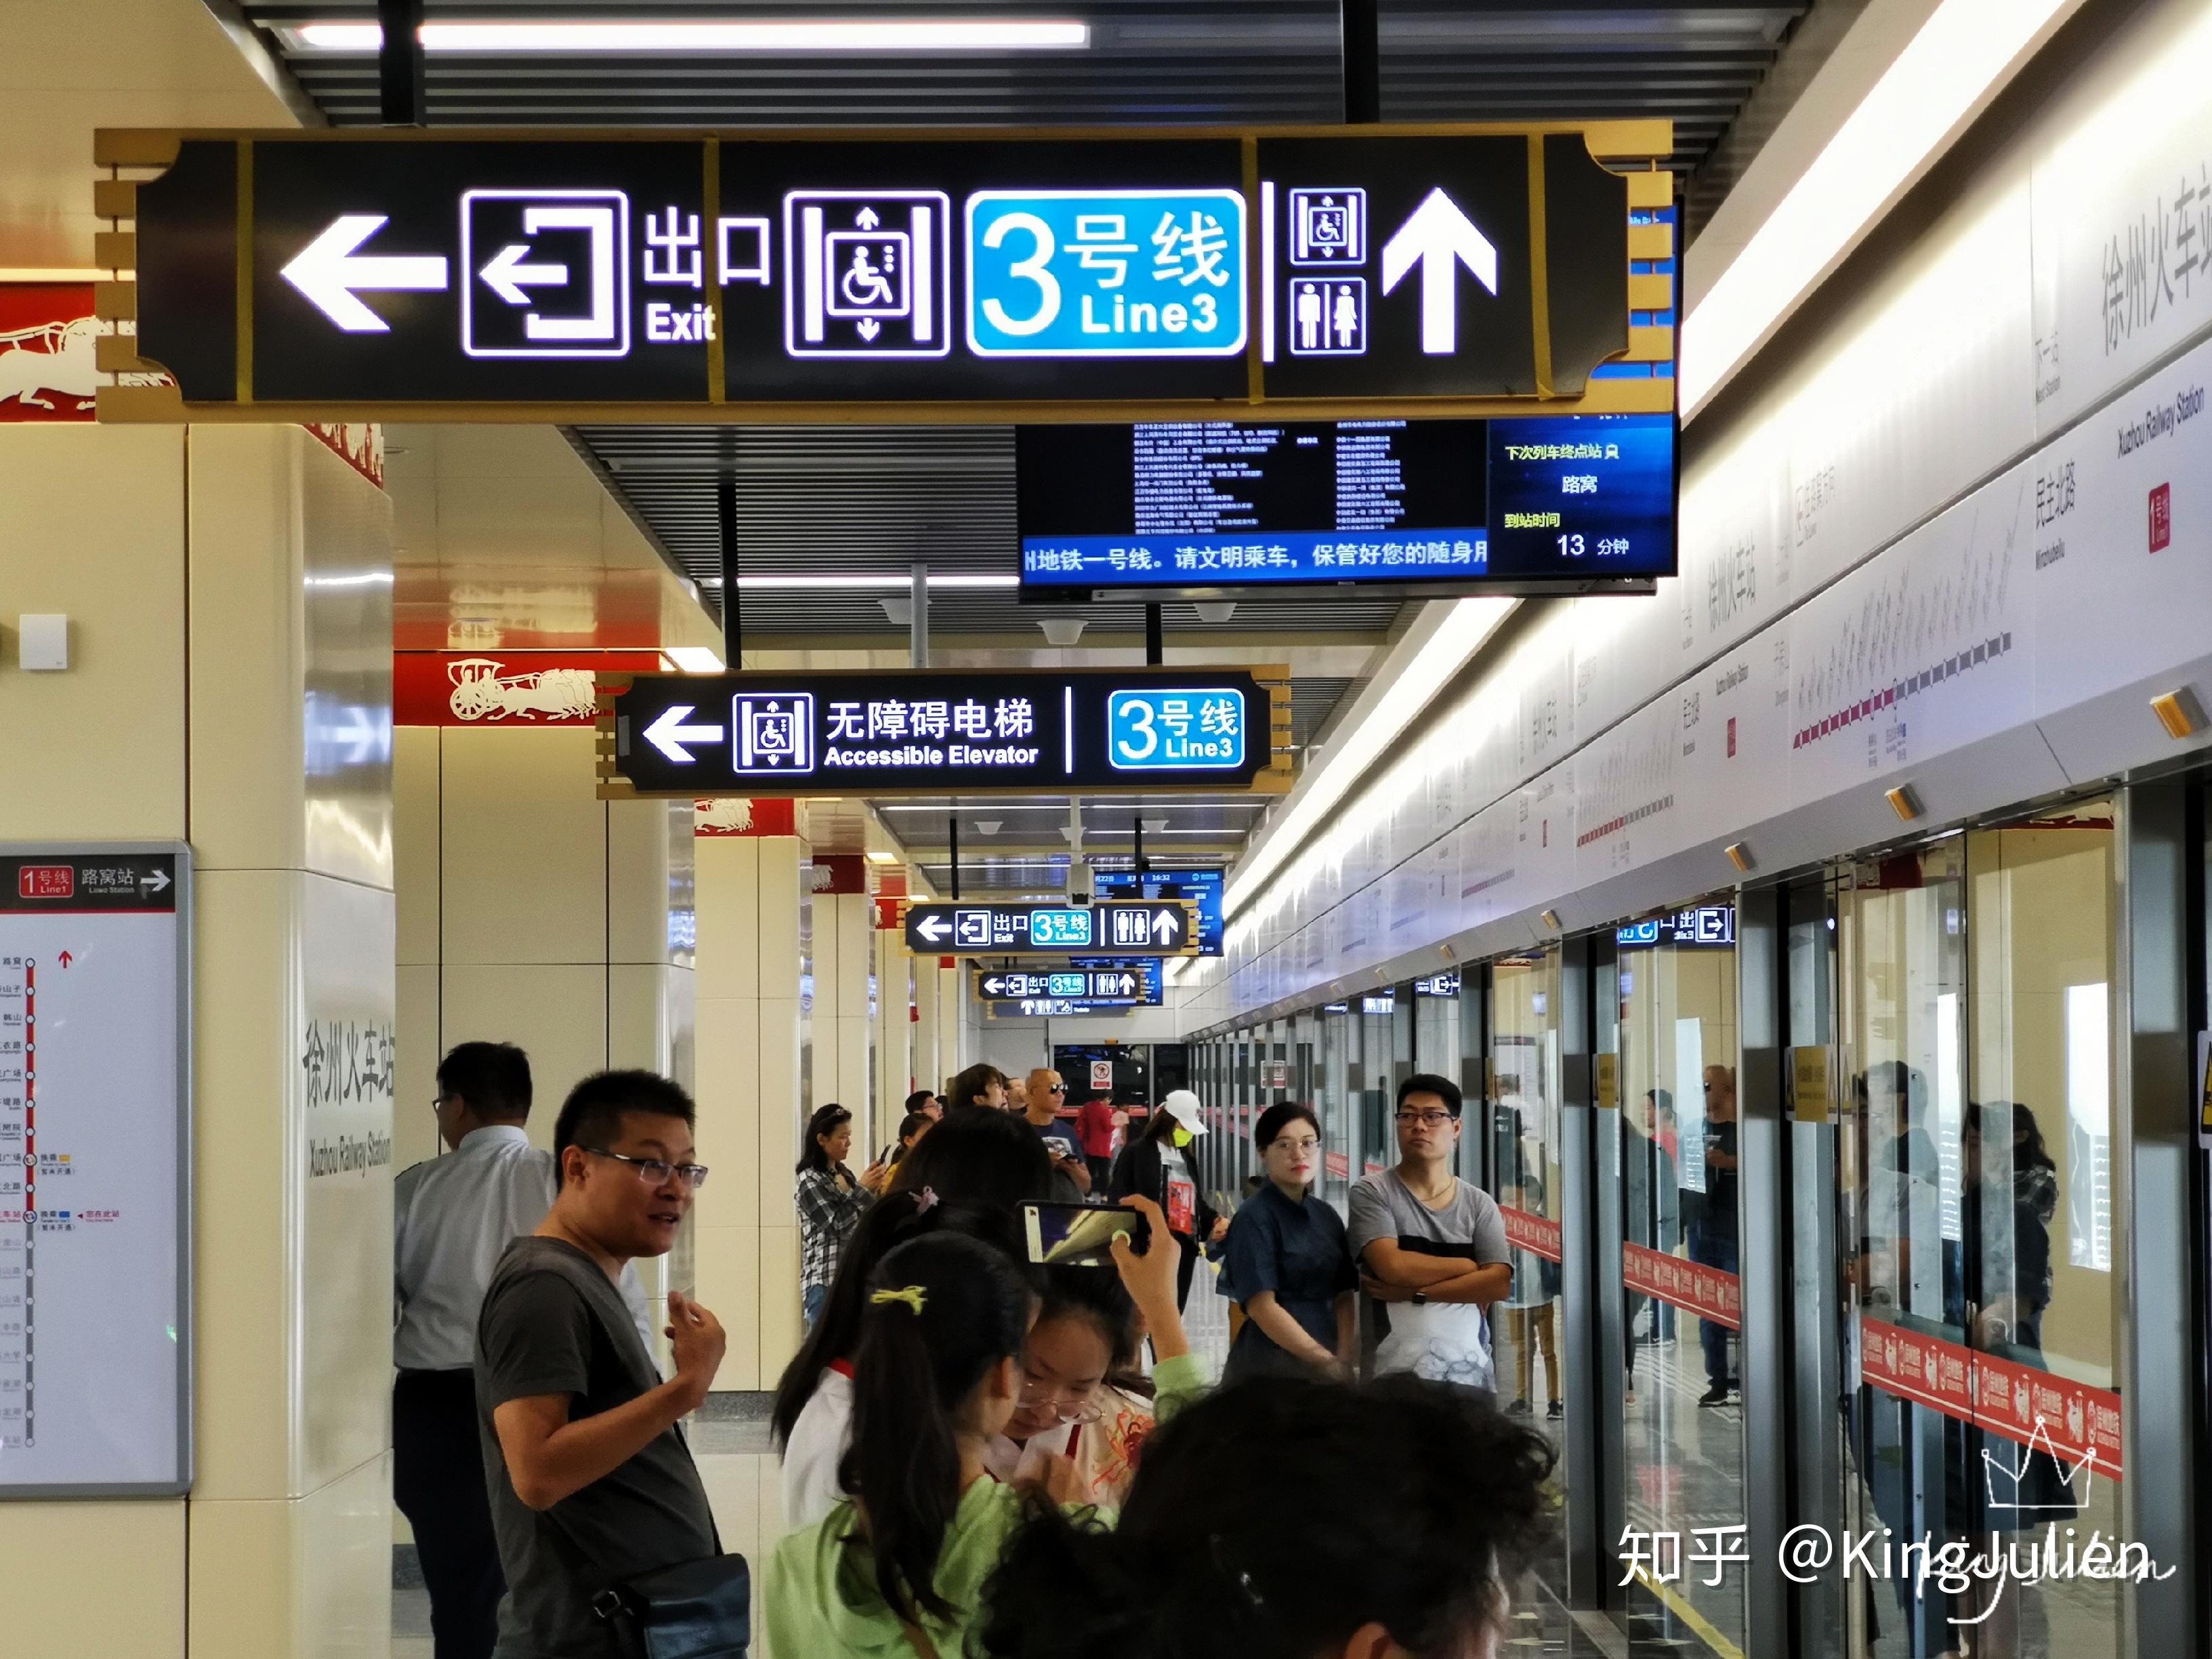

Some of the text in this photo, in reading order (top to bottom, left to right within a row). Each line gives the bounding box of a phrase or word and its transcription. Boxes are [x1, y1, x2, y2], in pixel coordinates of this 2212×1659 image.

[644, 207, 770, 287] 出口
[982, 211, 1230, 336] 3号线
[646, 303, 715, 341] Exit
[1081, 293, 1218, 333] Line3
[2118, 384, 2204, 459] Xuzhou Railway Station
[1505, 444, 1602, 461] 下次列车终点站
[1562, 475, 1598, 494] 路窝
[2036, 458, 2076, 530] 民主北路
[1505, 512, 1560, 528] 到站时间
[1558, 534, 1629, 556] 13 分钟
[827, 698, 1033, 740] 无障碍电梯
[1118, 699, 1239, 759] 3号线
[824, 745, 1039, 766] Accessible Elevator
[1166, 738, 1233, 757] Line3
[24, 870, 69, 894] 1号线
[82, 868, 134, 885] 路窝站
[994, 914, 1028, 932] 出口
[1035, 914, 1088, 941] 3号线
[1028, 976, 1049, 987] 出口
[303, 1019, 395, 1108] 徐州火车站
